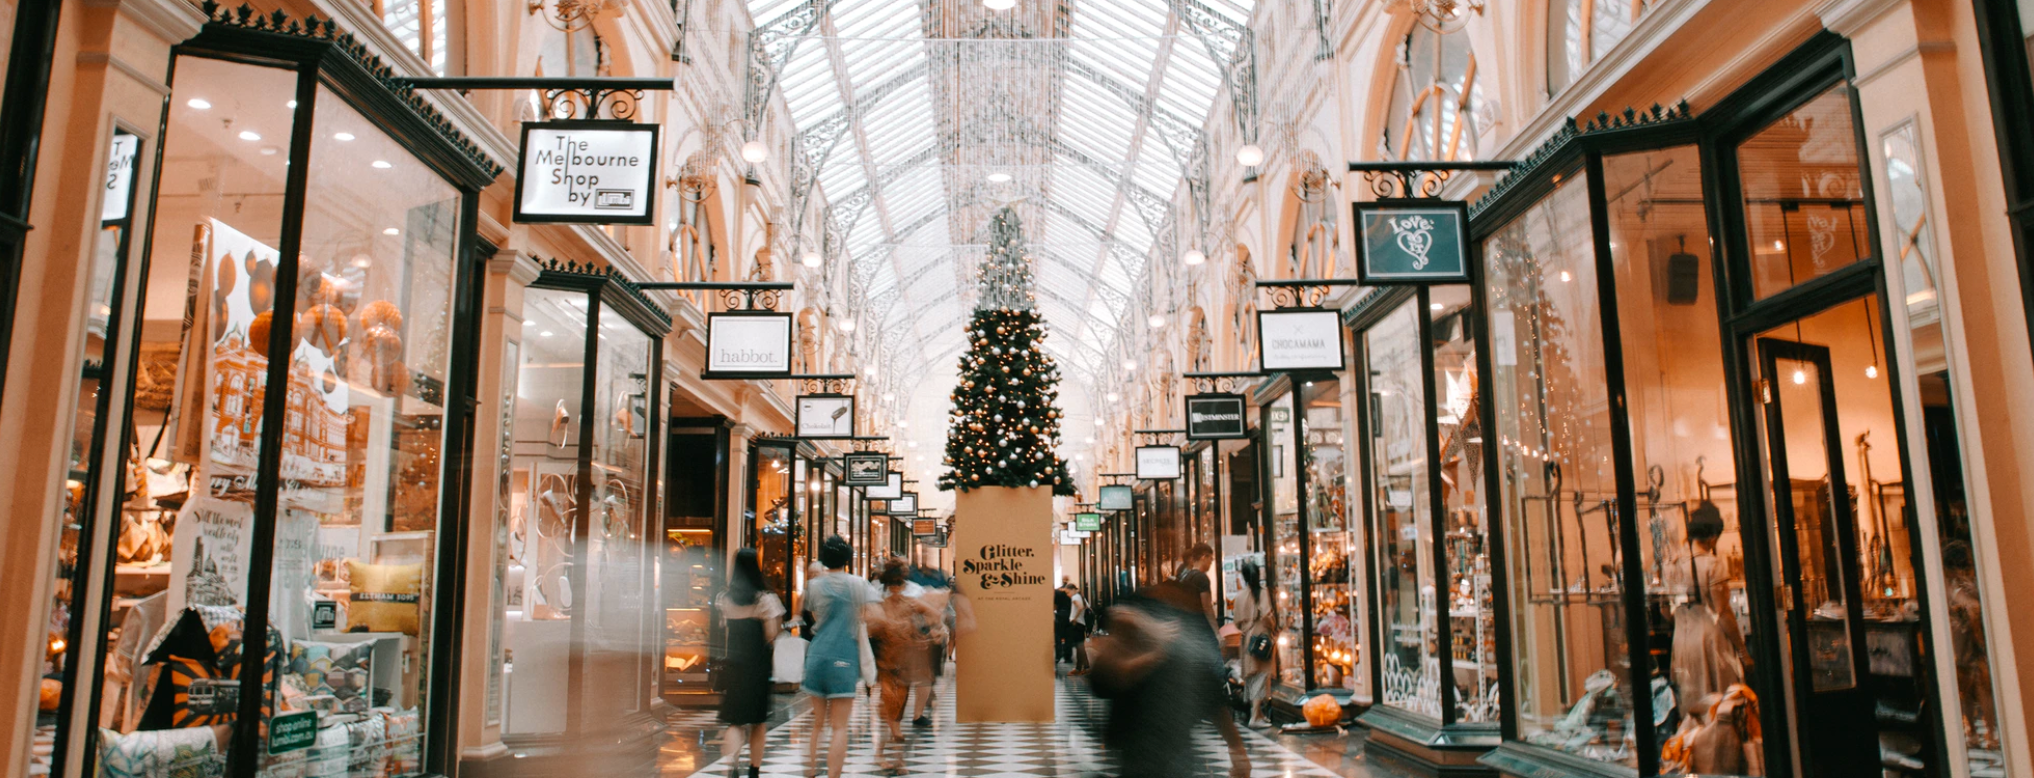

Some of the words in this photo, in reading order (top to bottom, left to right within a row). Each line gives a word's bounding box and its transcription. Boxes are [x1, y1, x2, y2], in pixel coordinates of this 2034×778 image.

[556, 135, 589, 151] The
[535, 149, 639, 167] Melbourne
[551, 168, 599, 189] Shop
[568, 188, 591, 206] by
[1271, 338, 1326, 350] CHOCAMAMA
[720, 349, 778, 363] habbot.
[980, 544, 1034, 561] Glitter.
[963, 558, 1023, 575] Sparkle
